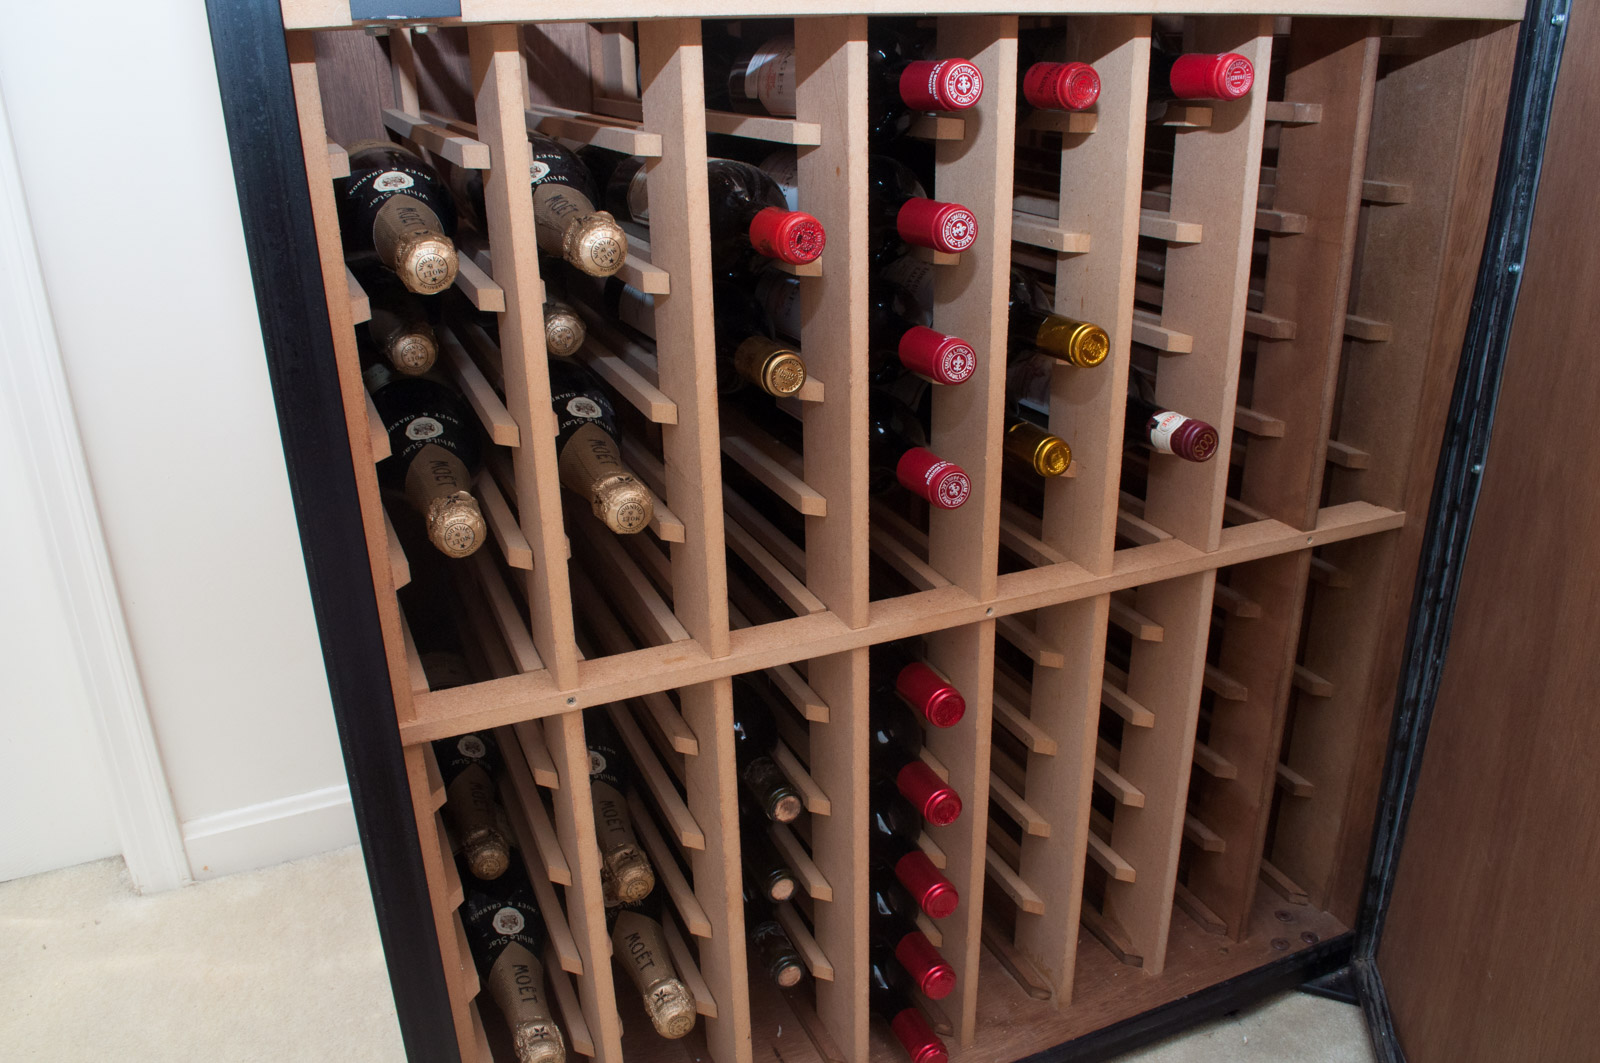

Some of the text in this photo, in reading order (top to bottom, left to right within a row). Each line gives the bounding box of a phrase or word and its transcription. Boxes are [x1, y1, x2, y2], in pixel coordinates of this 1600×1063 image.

[348, 169, 384, 195] CHANDON
[535, 175, 569, 185] White
[368, 188, 430, 208] White Star
[591, 239, 616, 260] CHANDON
[418, 254, 445, 271] CHANDON
[560, 417, 584, 430] Star
[400, 437, 458, 456] White Star
[1195, 434, 1214, 456] COS
[619, 504, 645, 517] CHANDON
[446, 525, 473, 542] CHANDON
[469, 902, 502, 922] CHANDON
[487, 932, 536, 949] White Star
